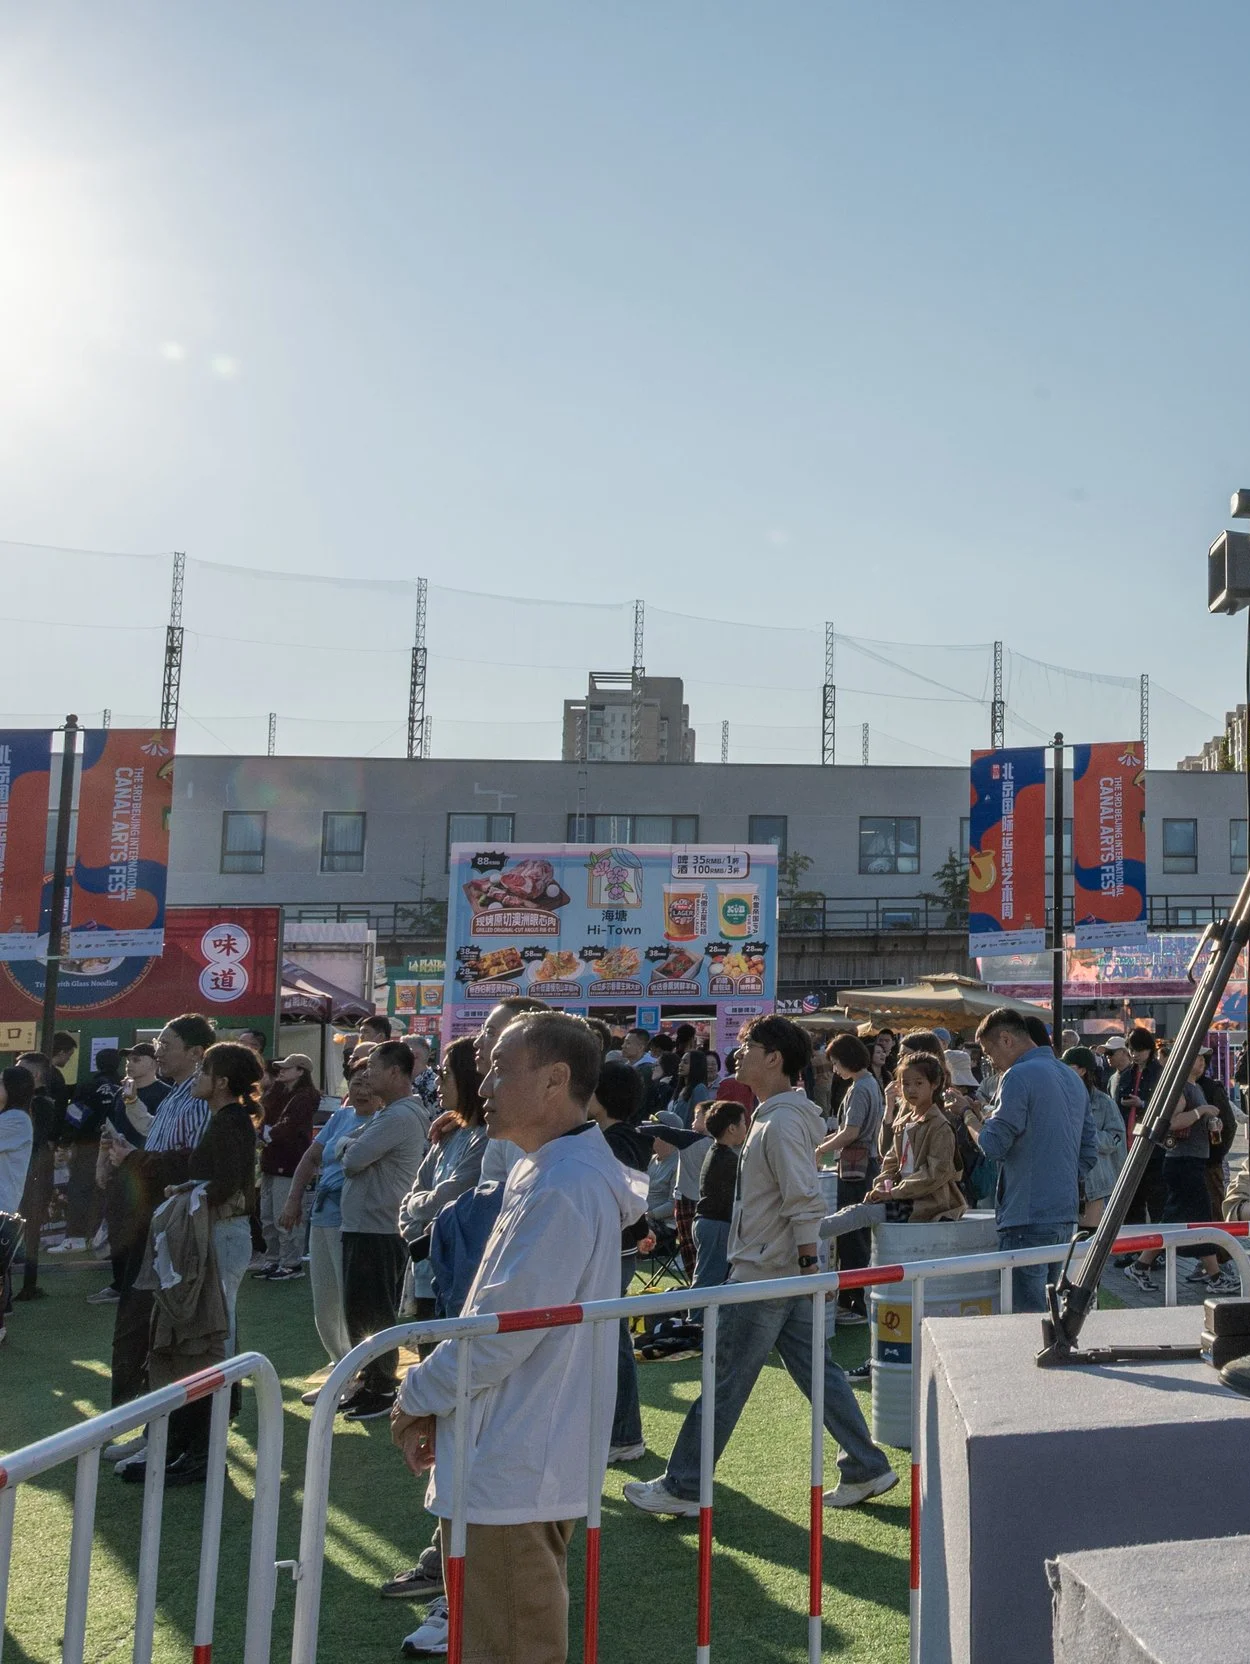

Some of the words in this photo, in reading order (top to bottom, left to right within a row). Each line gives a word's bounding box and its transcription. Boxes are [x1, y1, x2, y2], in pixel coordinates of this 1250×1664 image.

[132, 784, 144, 800] 3RD
[134, 766, 144, 783] THE
[1114, 776, 1122, 791] THE
[112, 767, 134, 819] CANAL
[1099, 777, 1114, 824] CANAL
[1114, 792, 1122, 807] 3RD
[130, 801, 142, 836] BEIJING
[1114, 808, 1122, 839] BEIJING
[110, 820, 130, 863] ARTS
[1001, 762, 1014, 920] 北京国际运河艺术周
[1100, 825, 1114, 863] ARTS
[108, 865, 128, 902] FEST
[126, 837, 141, 901] INTERNATIONAL
[1100, 865, 1116, 897] FEST
[1114, 840, 1124, 897] INTERNATIONAL
[587, 925, 642, 935] Hi-Town
[602, 910, 628, 922] 海塘
[211, 933, 238, 992] 味道
[71, 980, 90, 988] Glass
